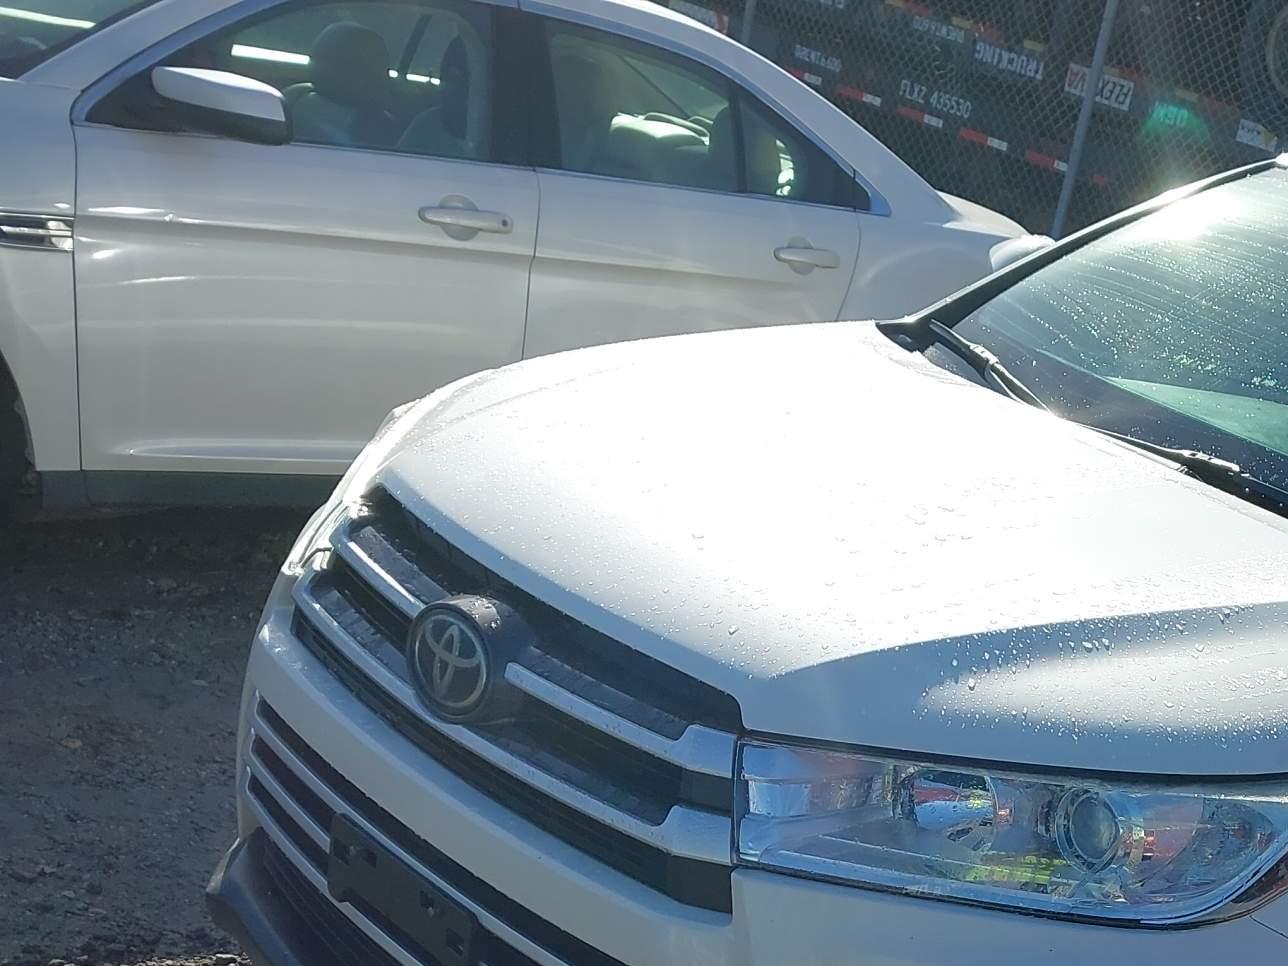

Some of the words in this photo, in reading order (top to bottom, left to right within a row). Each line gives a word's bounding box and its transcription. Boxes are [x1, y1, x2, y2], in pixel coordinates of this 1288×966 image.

[975, 42, 1044, 80] TRUCKING
[899, 80, 927, 104] FLXZ
[930, 90, 972, 118] 435530
